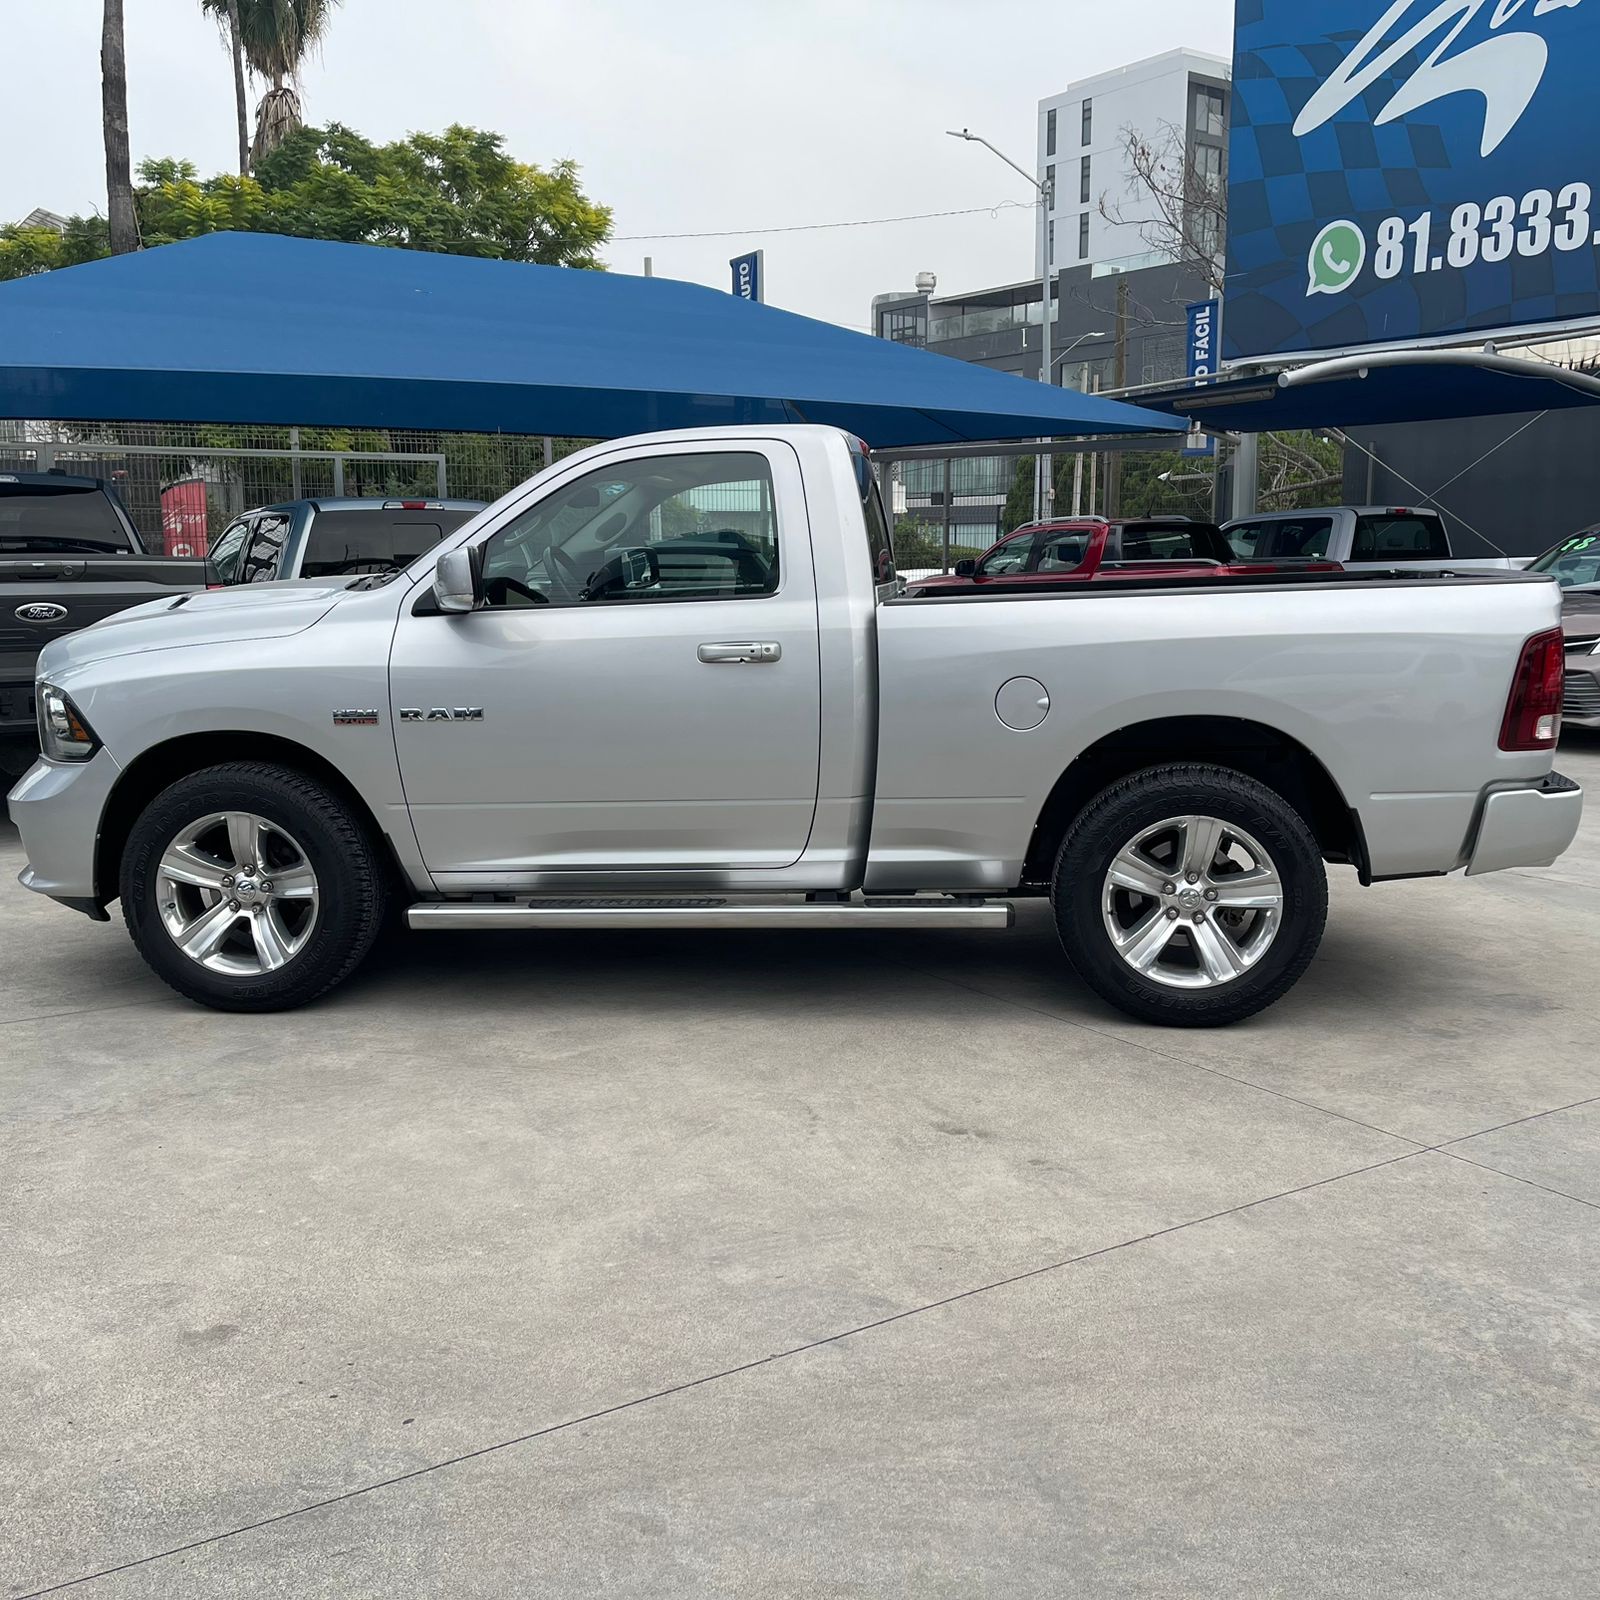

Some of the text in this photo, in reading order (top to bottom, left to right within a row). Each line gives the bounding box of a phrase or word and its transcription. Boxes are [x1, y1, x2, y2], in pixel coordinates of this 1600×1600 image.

[1373, 182, 1600, 280] 81.8333.
[739, 262, 751, 300] UTO
[1192, 305, 1210, 361] FÁCIL
[27, 606, 56, 618] Ford
[400, 707, 485, 722] RAM
